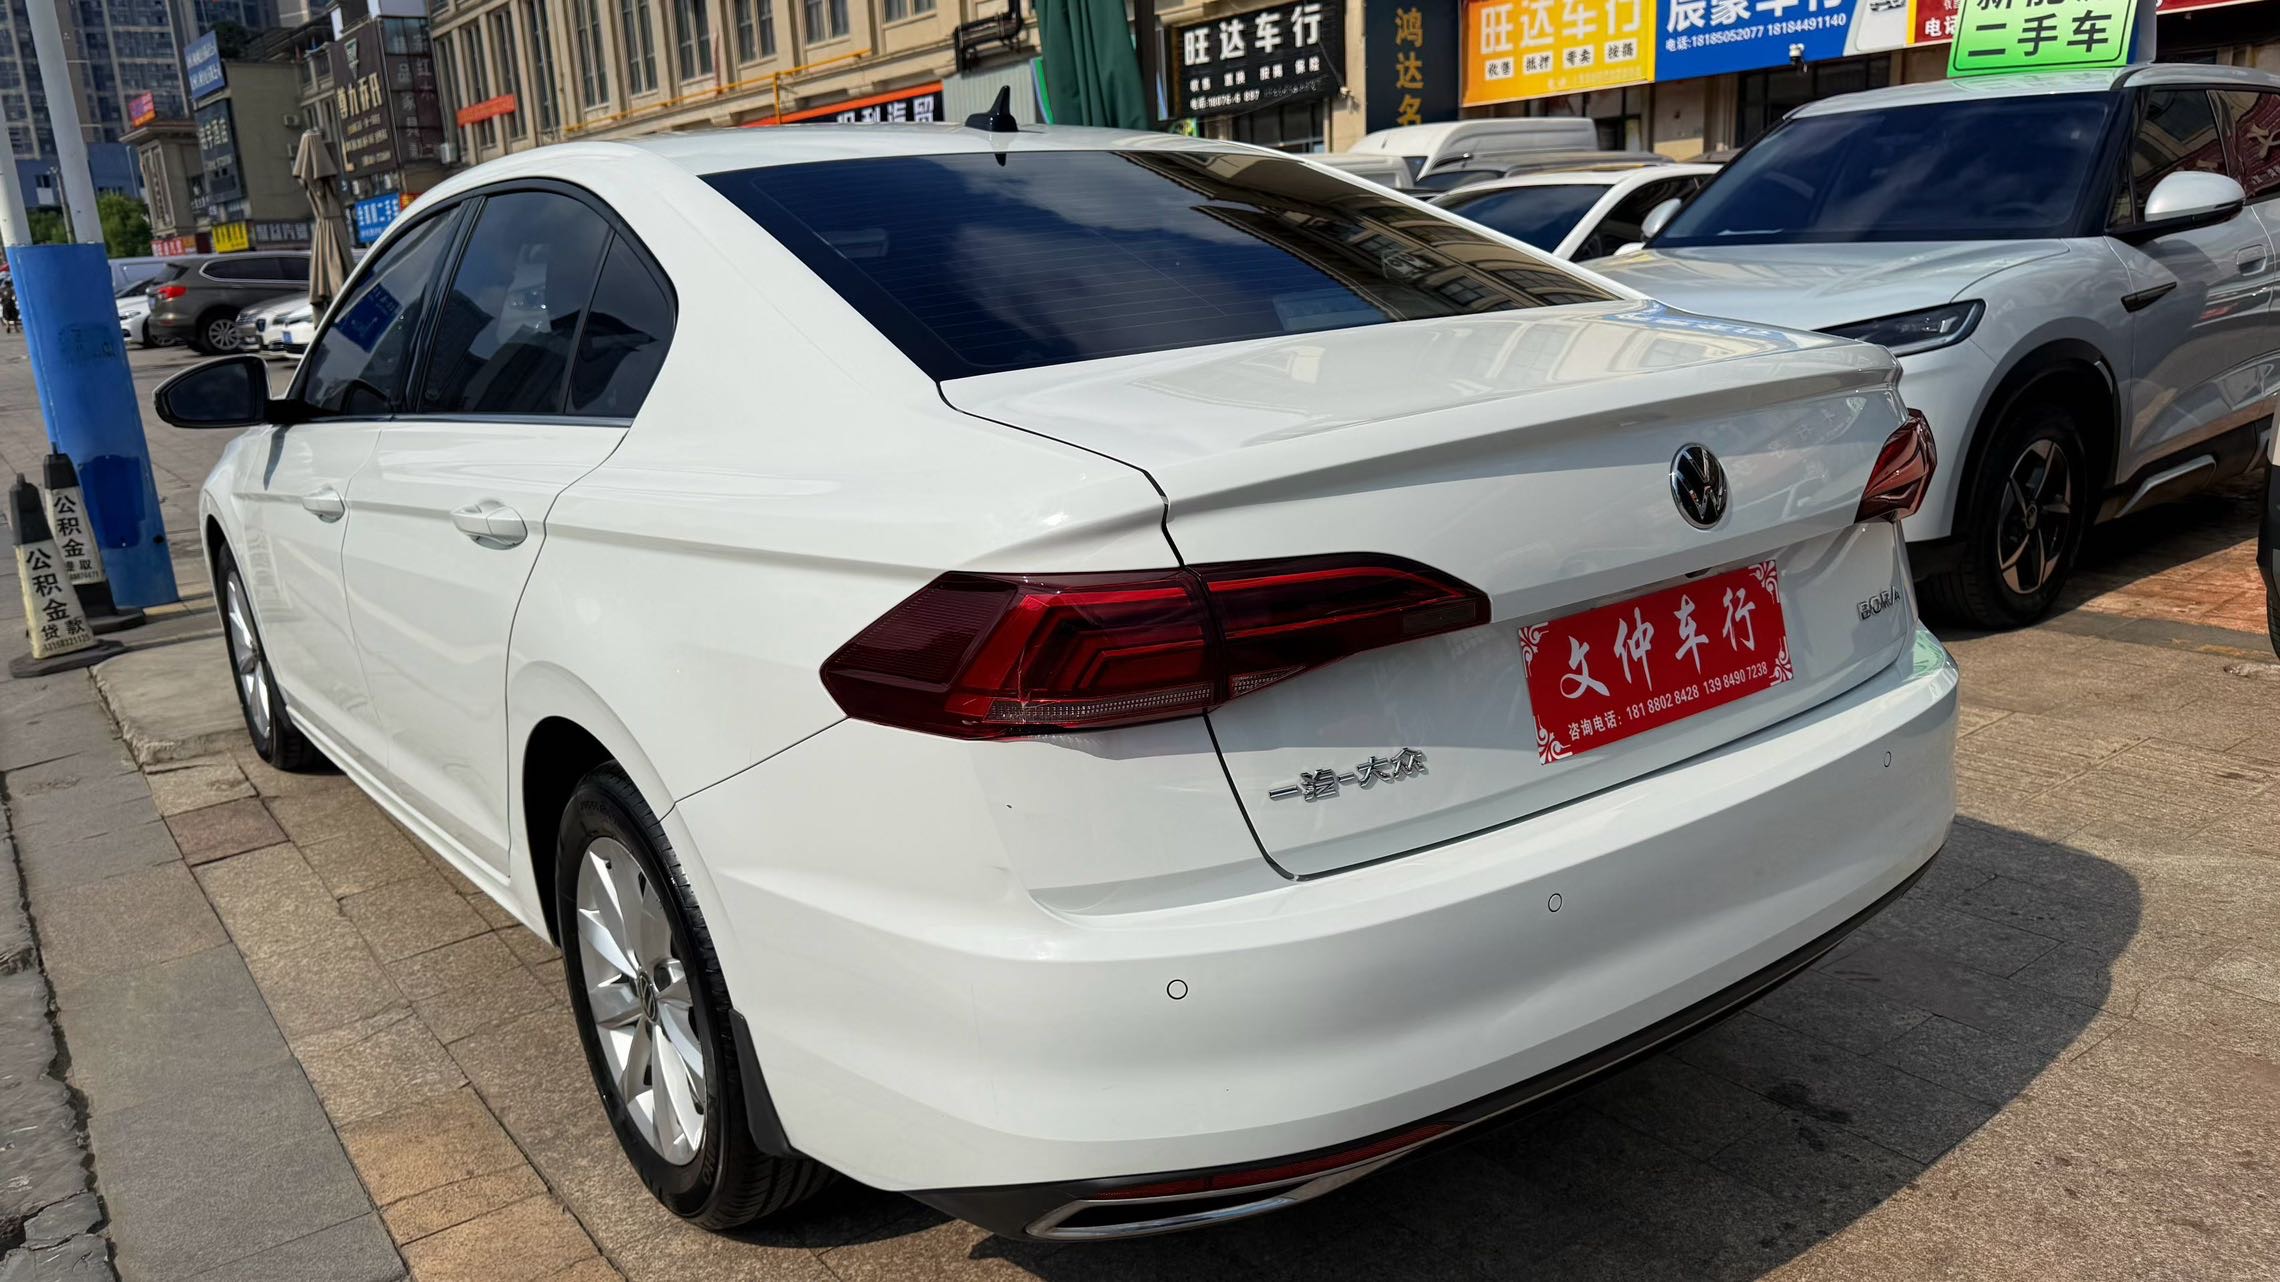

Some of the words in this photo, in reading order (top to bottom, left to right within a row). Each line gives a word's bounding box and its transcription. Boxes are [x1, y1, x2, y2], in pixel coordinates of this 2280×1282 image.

[1183, 3, 1322, 66] 旺达车行
[1480, 0, 1641, 54] 旺达车行
[1768, 13, 1846, 36] 18184491140
[1967, 10, 2112, 57] 二手车
[1395, 8, 1424, 126] 鸿达名
[53, 495, 85, 558] 公积金
[26, 547, 70, 622] 公积金
[1857, 585, 1900, 621] BORA
[41, 618, 85, 641] 贷款
[1560, 586, 1756, 699] 文仲车行
[1626, 702, 1646, 721] 181
[1647, 694, 1674, 715] 8802
[1674, 685, 1700, 706] 8428
[1704, 677, 1722, 695] 139
[1723, 670, 1746, 690] 8490
[1746, 661, 1768, 681] 7238
[1269, 747, 1427, 801] 一汽-大众
